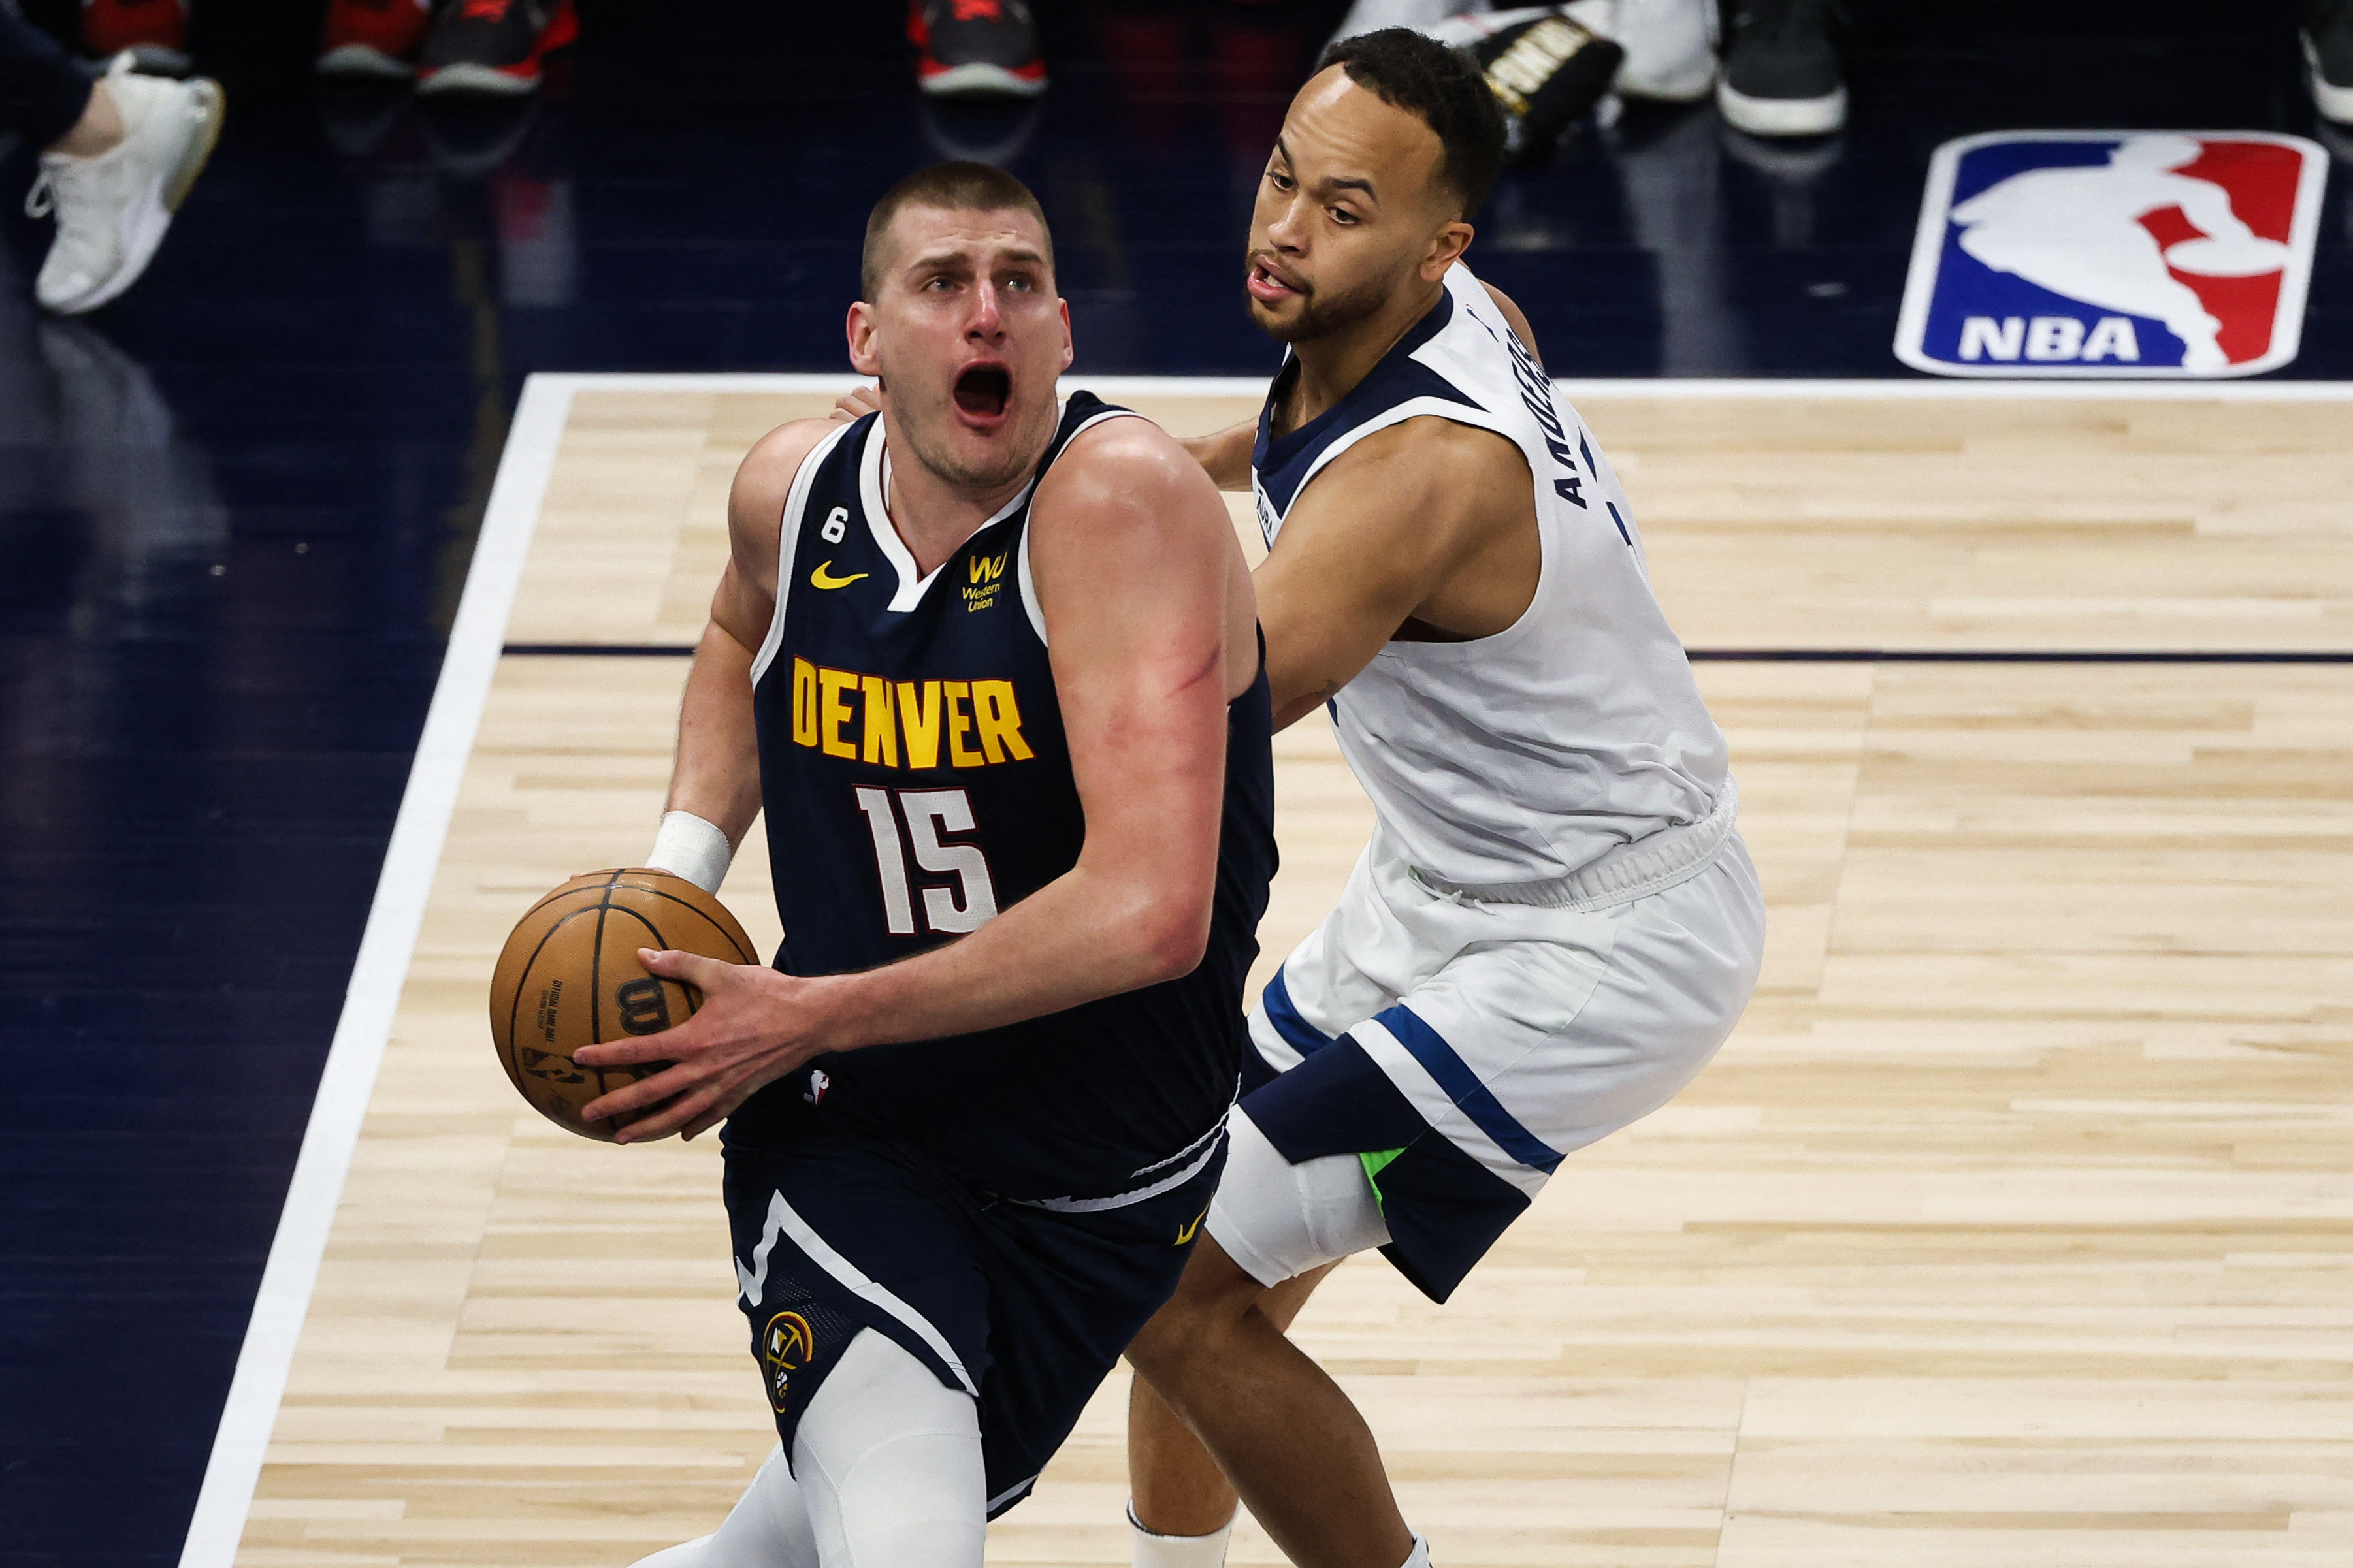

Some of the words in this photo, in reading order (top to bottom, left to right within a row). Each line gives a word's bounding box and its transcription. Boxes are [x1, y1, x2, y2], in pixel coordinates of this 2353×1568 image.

[1958, 315, 2141, 362] NBA
[820, 505, 849, 545] 6
[969, 551, 1008, 584] WU
[962, 583, 1001, 600] Western
[967, 597, 994, 613] Union
[792, 654, 1036, 770] DENVER
[852, 784, 1000, 935] 15
